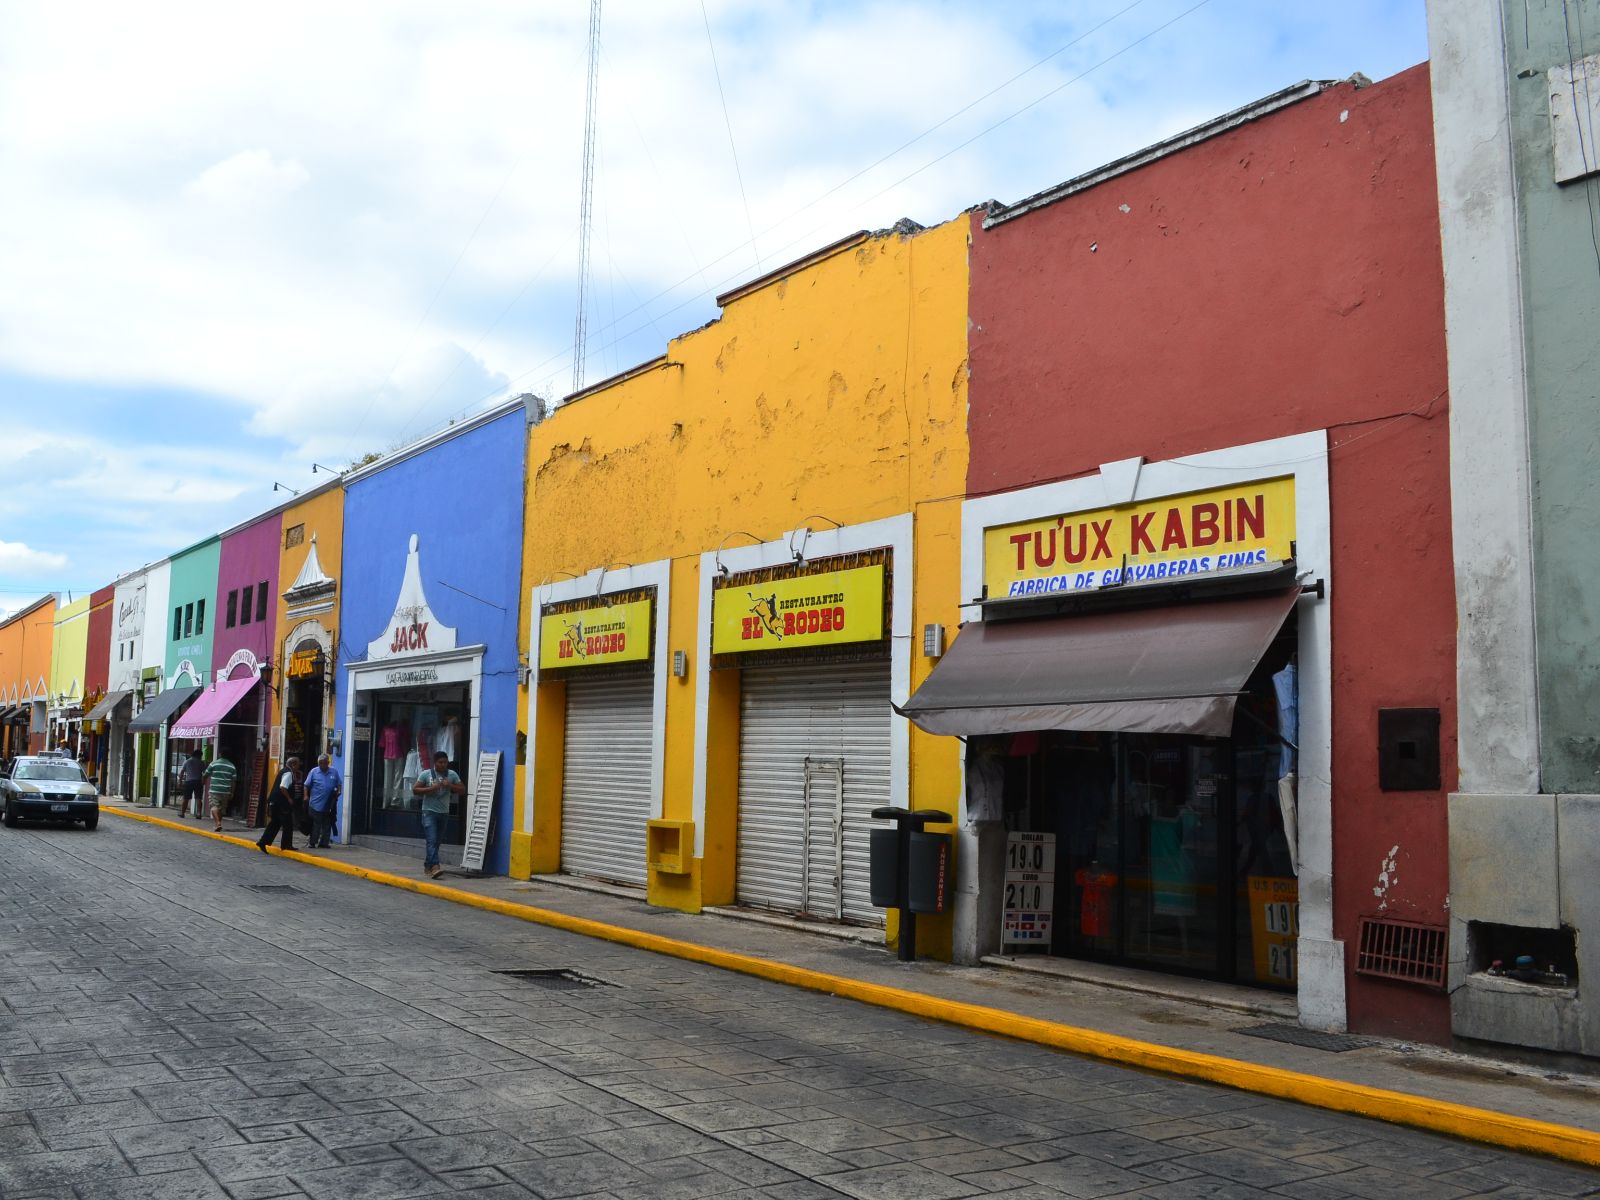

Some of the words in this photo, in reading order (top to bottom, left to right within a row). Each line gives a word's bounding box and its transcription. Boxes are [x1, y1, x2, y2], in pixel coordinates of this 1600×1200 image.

[1009, 517, 1113, 571] TU'UX
[1130, 494, 1265, 556] KABIN
[1009, 576, 1068, 597] FABRICA
[1074, 571, 1095, 589] DE
[1102, 557, 1210, 587] GUAYABERAS
[741, 616, 764, 640] EL
[783, 606, 845, 636] RODEO
[391, 621, 429, 653] JACK
[559, 639, 574, 658] EL
[586, 632, 626, 656] RODEO
[169, 725, 214, 737] Miniaturas
[1009, 843, 1043, 870] 19.0
[1022, 873, 1039, 881] EURO
[1005, 883, 1040, 910] 21.0
